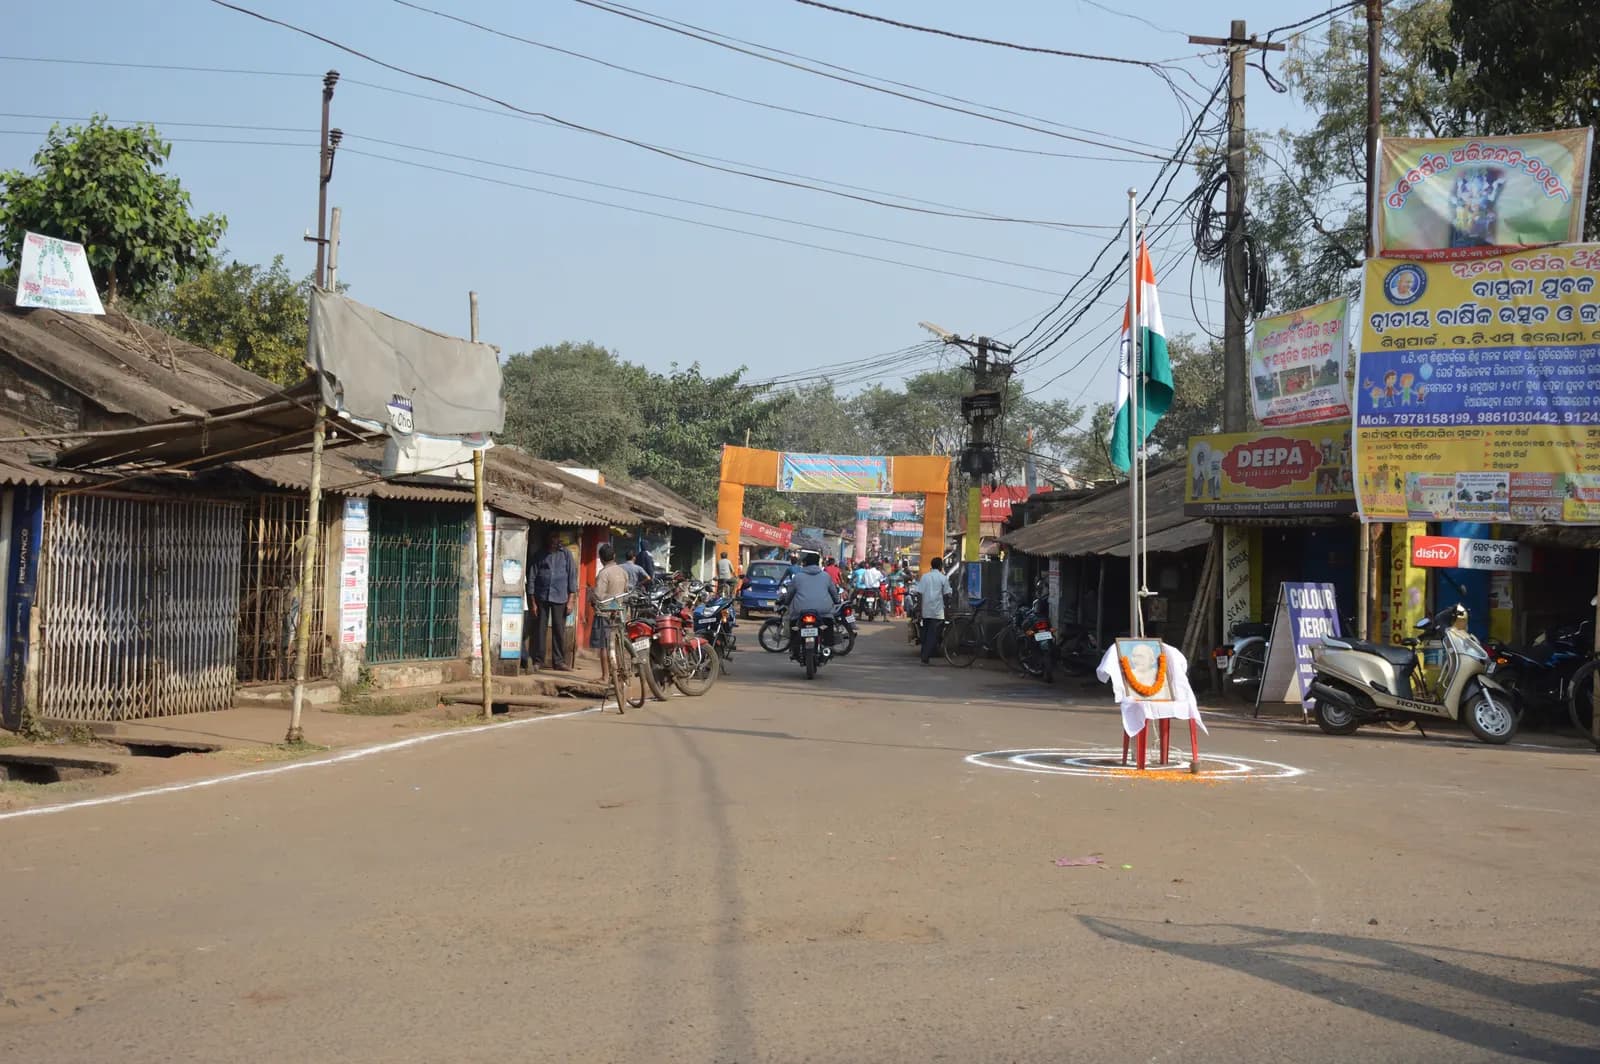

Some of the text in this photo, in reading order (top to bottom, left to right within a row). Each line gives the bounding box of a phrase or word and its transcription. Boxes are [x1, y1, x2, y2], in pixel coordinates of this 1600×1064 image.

[1452, 261, 1503, 278] ନୂତନ
[1511, 254, 1566, 271] ବର୍ଷର
[1473, 277, 1594, 300] ବାପୁଜୀ ଯୁବକ
[1437, 303, 1492, 325] ବାର୍ଷିକ
[1557, 305, 1574, 321] ଓ
[1360, 411, 1600, 425] Mob. 7978158199, 9861030442, 9124
[1237, 447, 1303, 468] DEEPA
[1290, 588, 1335, 610] COLOUR
[1227, 600, 1247, 622] SCAN
[1298, 617, 1334, 638] XEROX
[1396, 699, 1440, 713] HONDA
